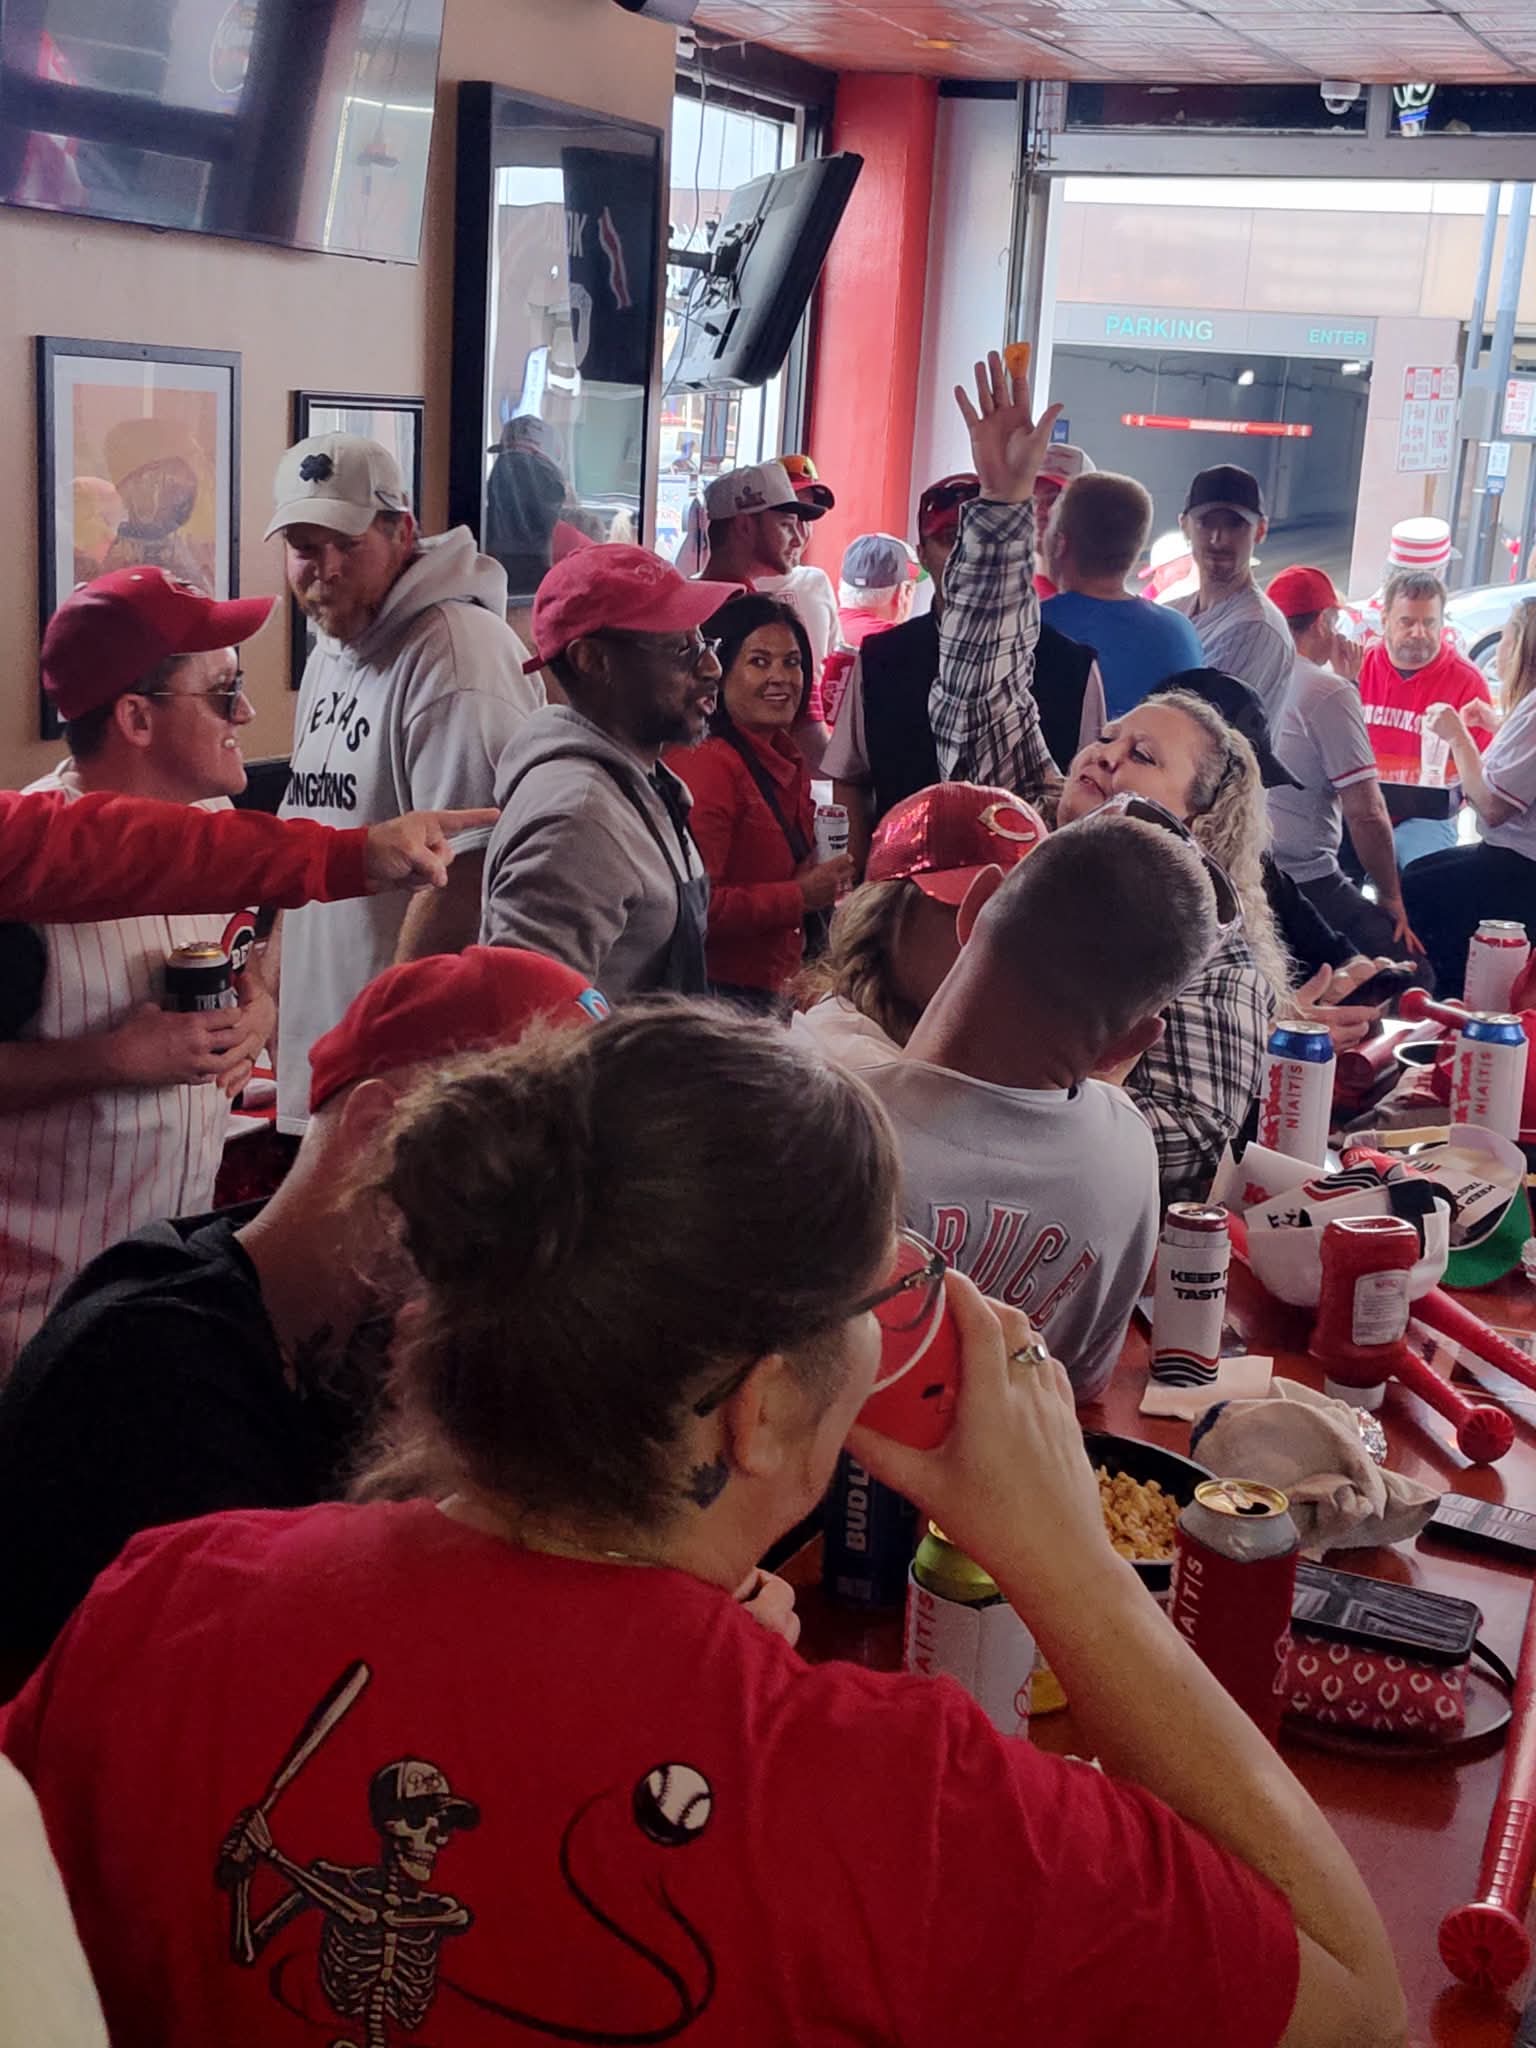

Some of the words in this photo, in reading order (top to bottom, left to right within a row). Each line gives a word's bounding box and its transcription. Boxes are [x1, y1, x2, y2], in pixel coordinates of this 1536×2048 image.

[1105, 315, 1214, 341] PARKING
[1308, 328, 1368, 345] ENTER
[298, 691, 370, 752] EXAS
[1170, 1269, 1221, 1283] KEEP
[846, 1491, 868, 1551] BUD
